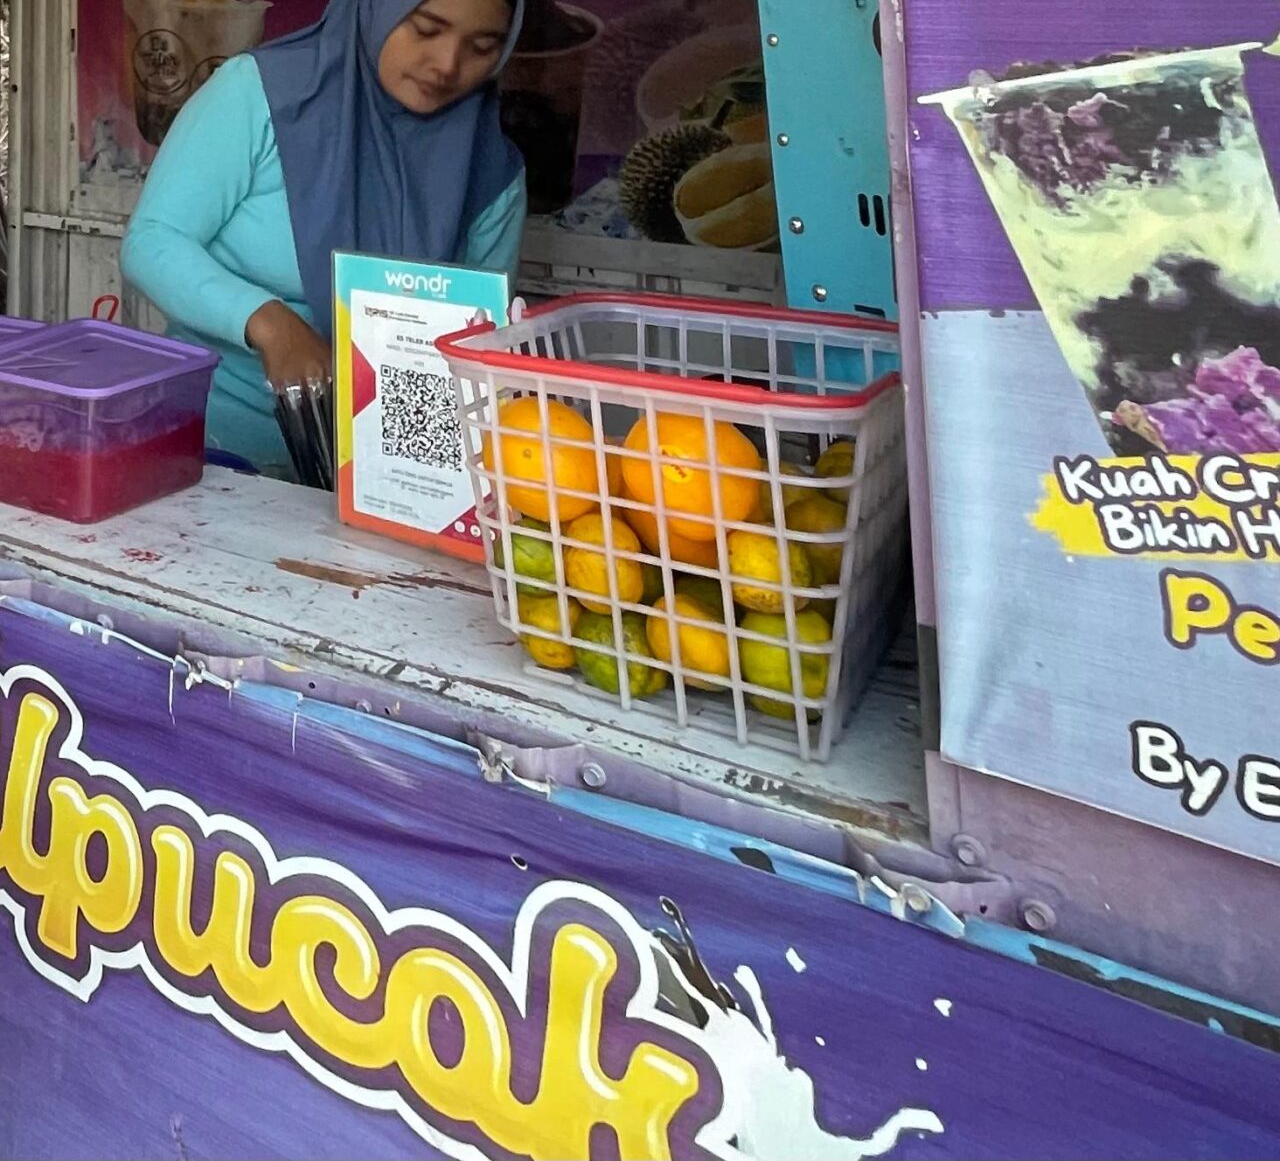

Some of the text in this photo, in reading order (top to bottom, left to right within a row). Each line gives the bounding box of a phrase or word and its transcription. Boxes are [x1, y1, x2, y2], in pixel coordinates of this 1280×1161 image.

[384, 270, 452, 294] wondr
[1057, 456, 1193, 501] Kuah
[1099, 503, 1231, 550] Bikin
[1165, 573, 1280, 660] Pe
[1135, 725, 1224, 812] By
